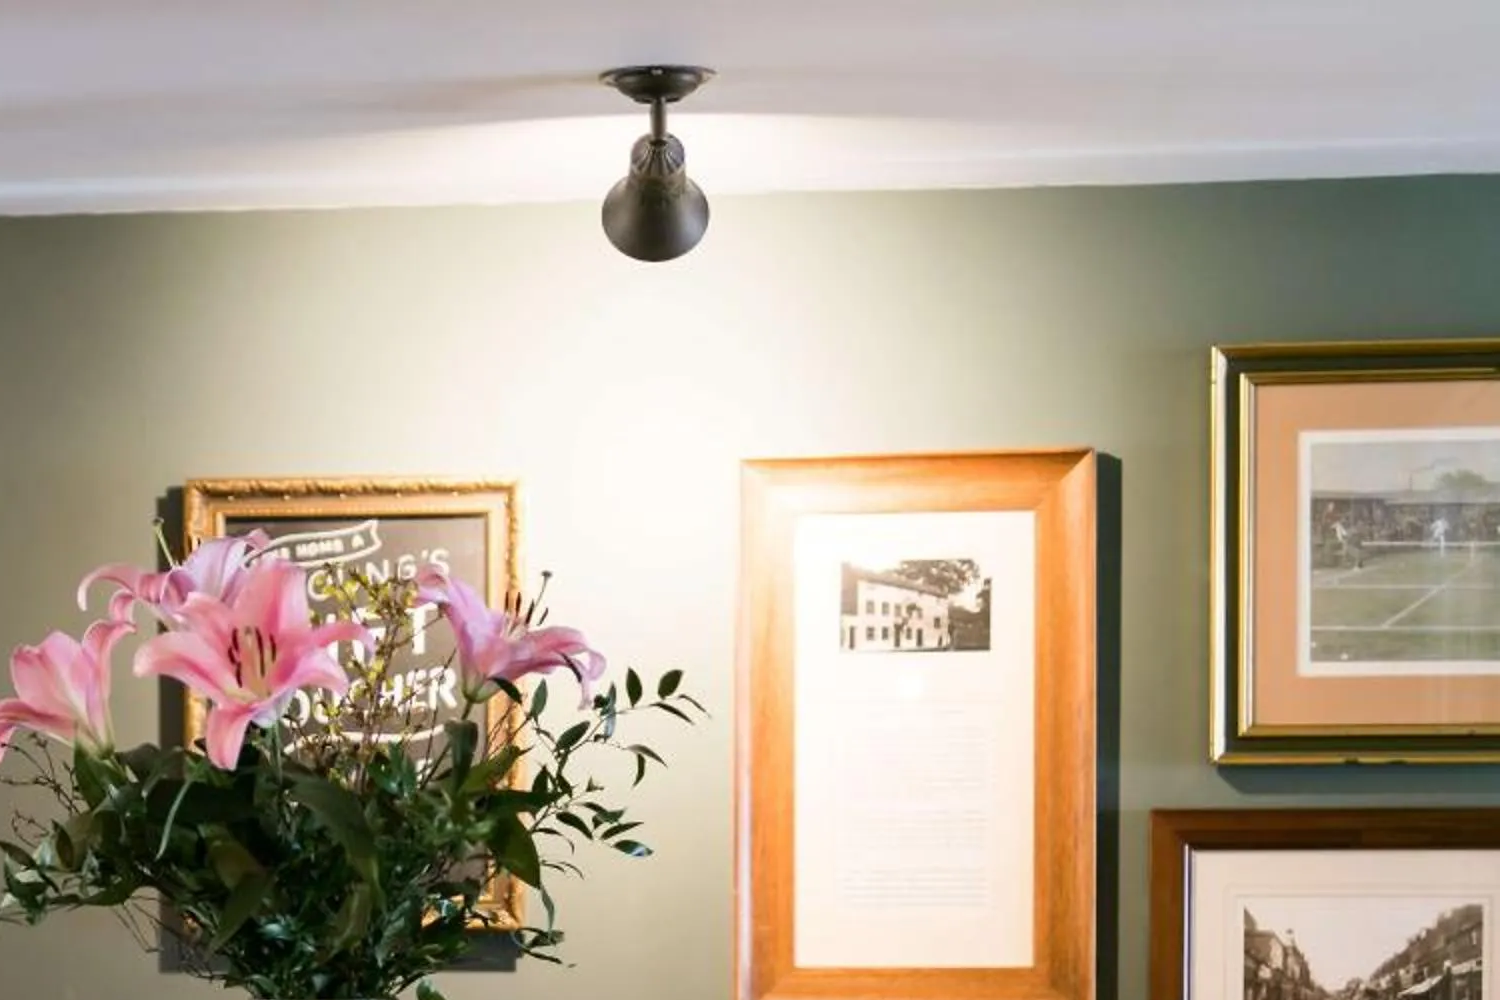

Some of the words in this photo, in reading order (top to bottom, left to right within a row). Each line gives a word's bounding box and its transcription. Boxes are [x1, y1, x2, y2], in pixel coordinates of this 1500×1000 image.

[351, 534, 365, 549] A
[307, 547, 451, 600] ONG'S
[325, 602, 439, 666] IFT
[280, 666, 458, 730] OUCHER
